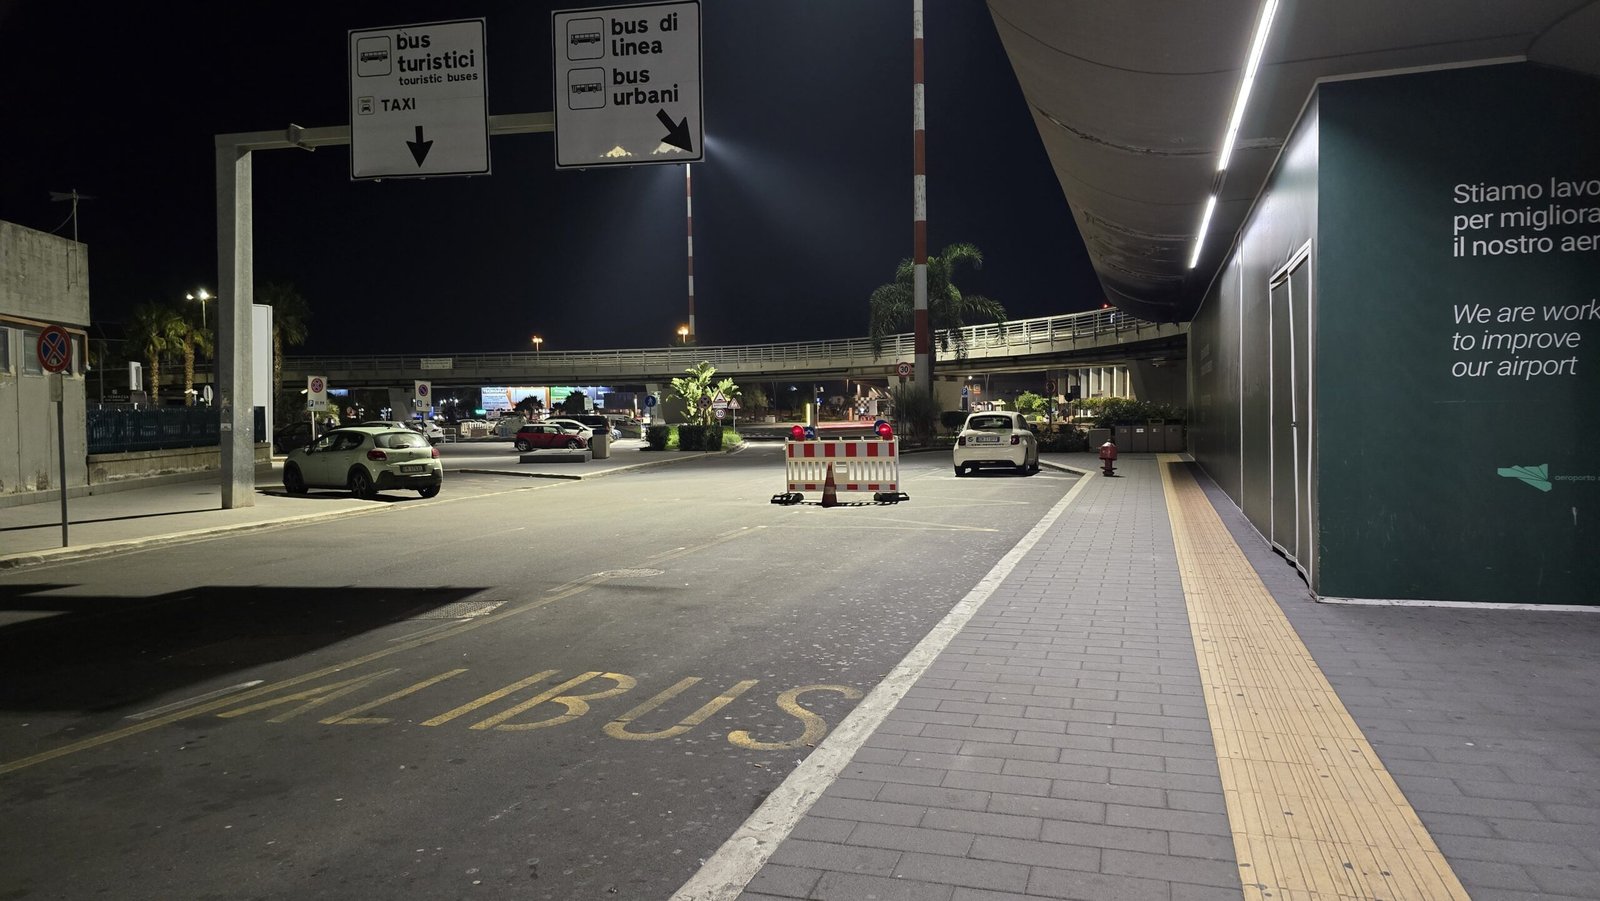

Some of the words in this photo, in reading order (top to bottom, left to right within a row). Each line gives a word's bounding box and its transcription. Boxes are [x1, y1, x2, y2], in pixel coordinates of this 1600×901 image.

[611, 18, 648, 35] bus
[660, 12, 678, 32] di
[396, 34, 431, 50] bus
[612, 37, 663, 56] linea
[397, 49, 475, 72] turistici
[399, 74, 443, 86] touristic
[447, 72, 478, 82] buses
[612, 68, 650, 85] bus
[381, 97, 416, 111] TAXI
[613, 83, 678, 105] urbani
[1453, 182, 1543, 204] Stiamo
[1550, 177, 1600, 198] lavo
[1453, 213, 1494, 236] per
[1453, 236, 1465, 257] il
[1472, 235, 1553, 256] nostro
[1453, 303, 1491, 324] We
[1497, 306, 1536, 323] are
[1543, 299, 1600, 321] work
[1452, 332, 1476, 351] to
[1481, 329, 1581, 354] improve
[1452, 360, 1493, 377] our
[1497, 355, 1579, 380] airport
[1554, 474, 1596, 484] aeroporto
[217, 668, 863, 751] ALIBUS
